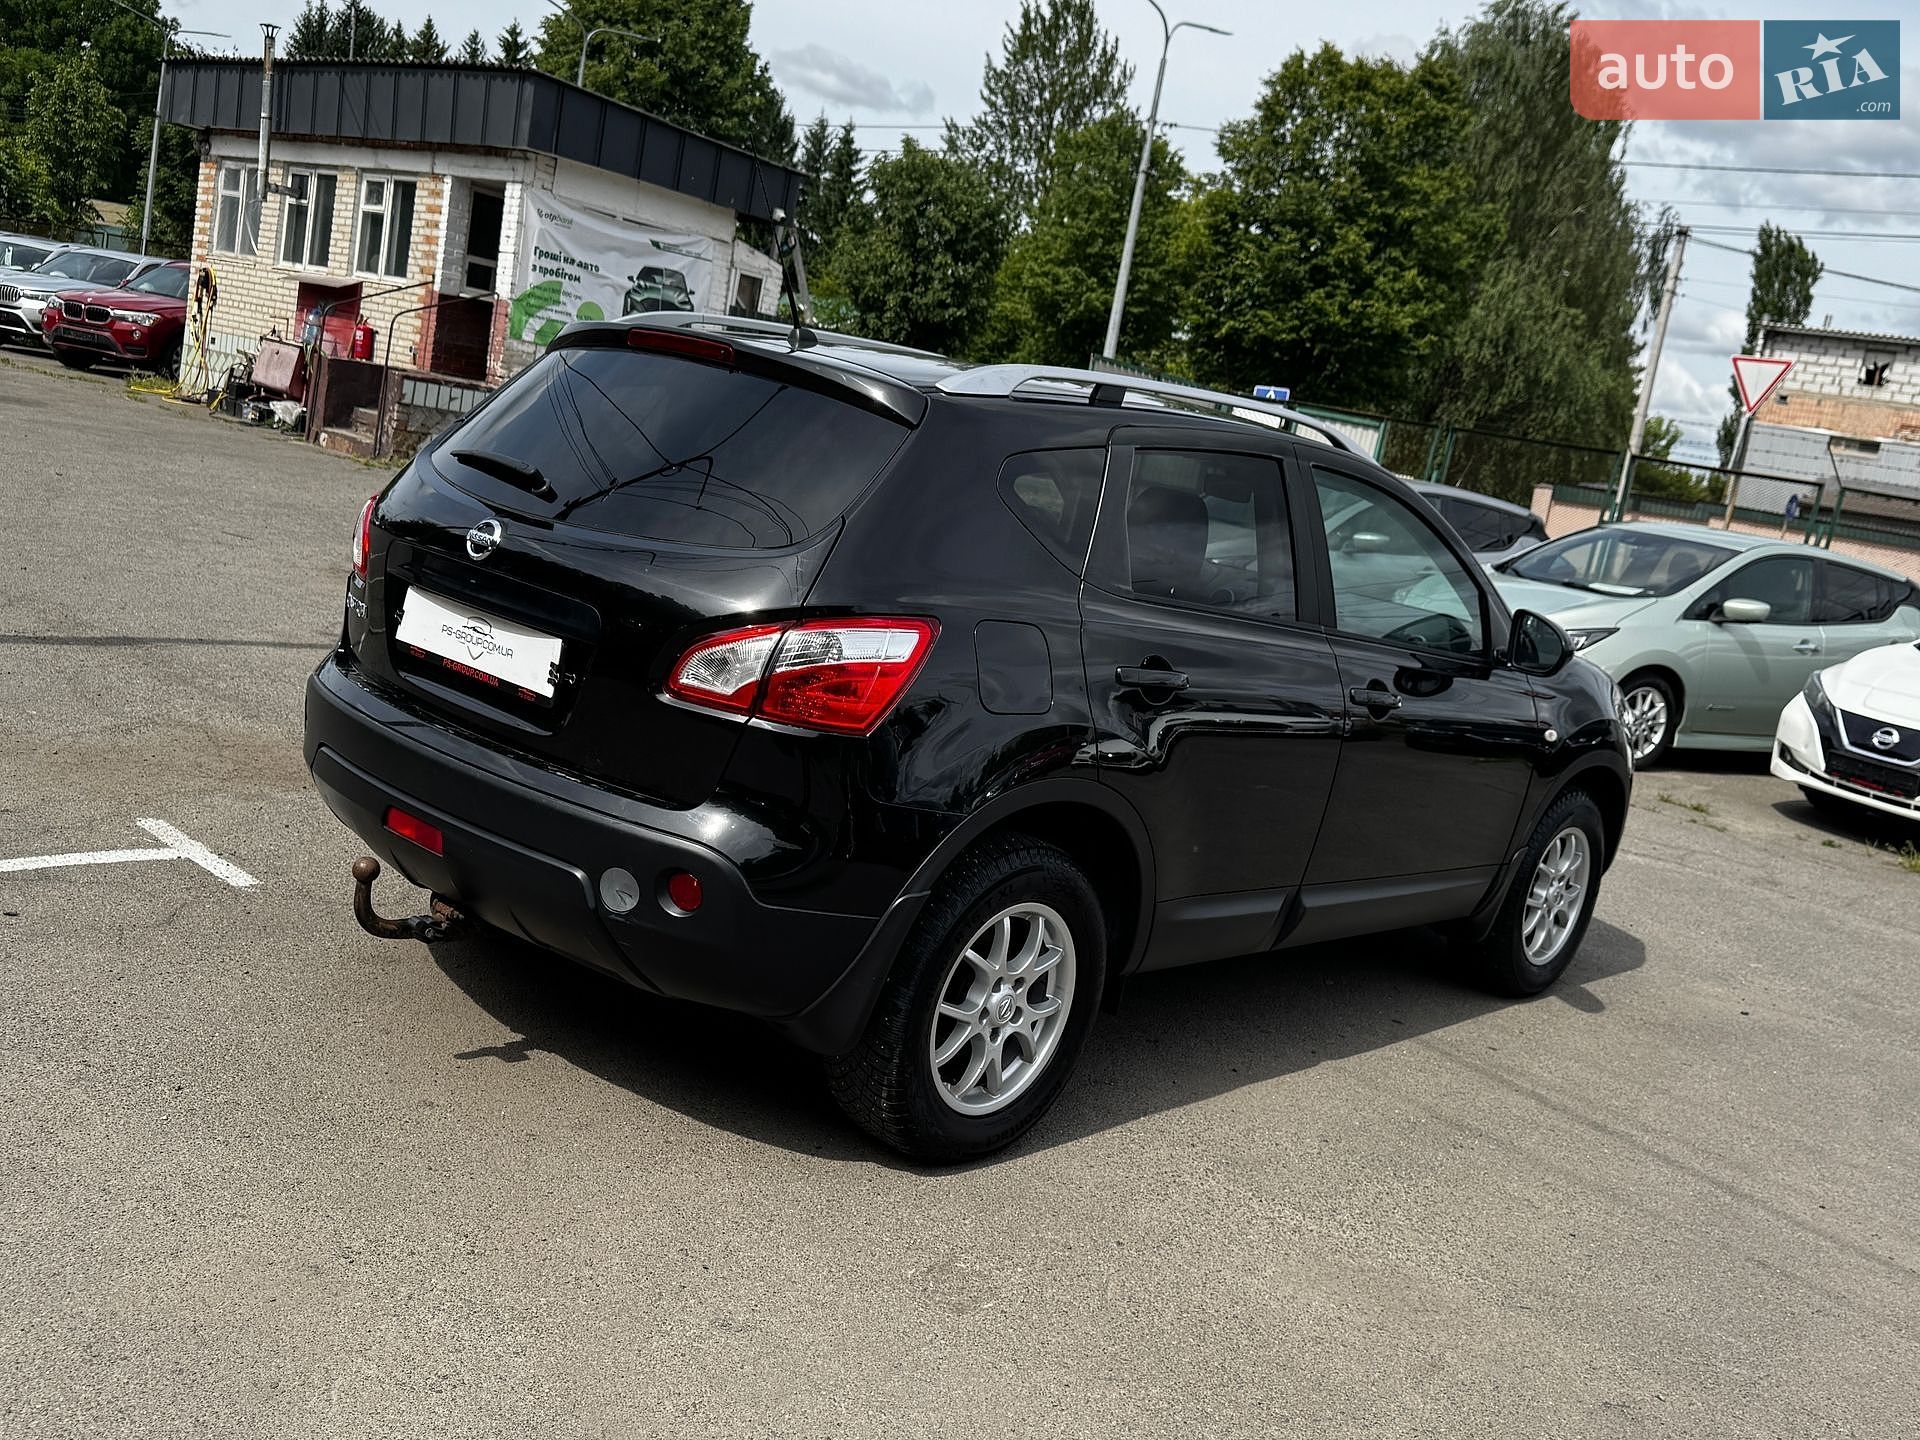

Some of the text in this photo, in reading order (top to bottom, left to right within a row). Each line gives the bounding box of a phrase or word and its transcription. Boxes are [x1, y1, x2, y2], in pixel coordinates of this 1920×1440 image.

[534, 246, 600, 273] Гроші на авто
[531, 264, 581, 284] з пробігом
[442, 659, 499, 687] PS-GROUP.COM.UA
